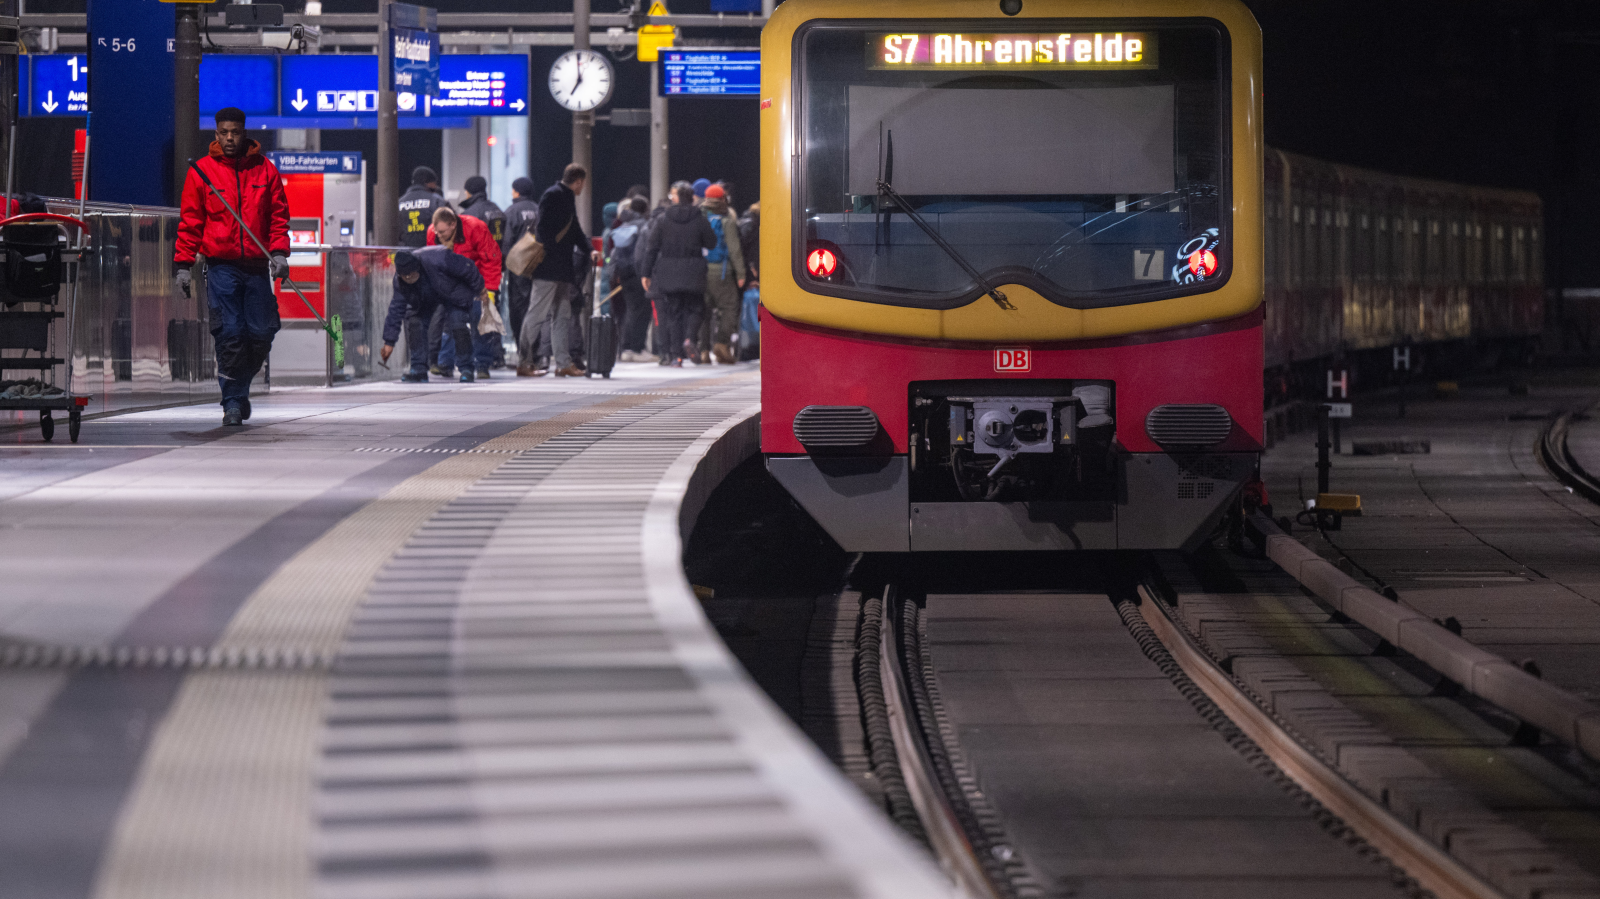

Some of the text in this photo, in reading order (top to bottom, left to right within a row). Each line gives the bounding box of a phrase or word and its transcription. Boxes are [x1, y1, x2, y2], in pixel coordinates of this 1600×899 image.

[112, 38, 136, 52] 5-6
[884, 33, 1143, 64] S7 Ahrensfelde
[67, 56, 88, 81] 1-
[280, 156, 338, 166] VBB-Fahrkarten
[399, 199, 430, 211] POLIZEI
[1140, 250, 1155, 276] 7
[999, 350, 1026, 367] DB
[1393, 347, 1410, 370] H
[1327, 370, 1347, 398] H
